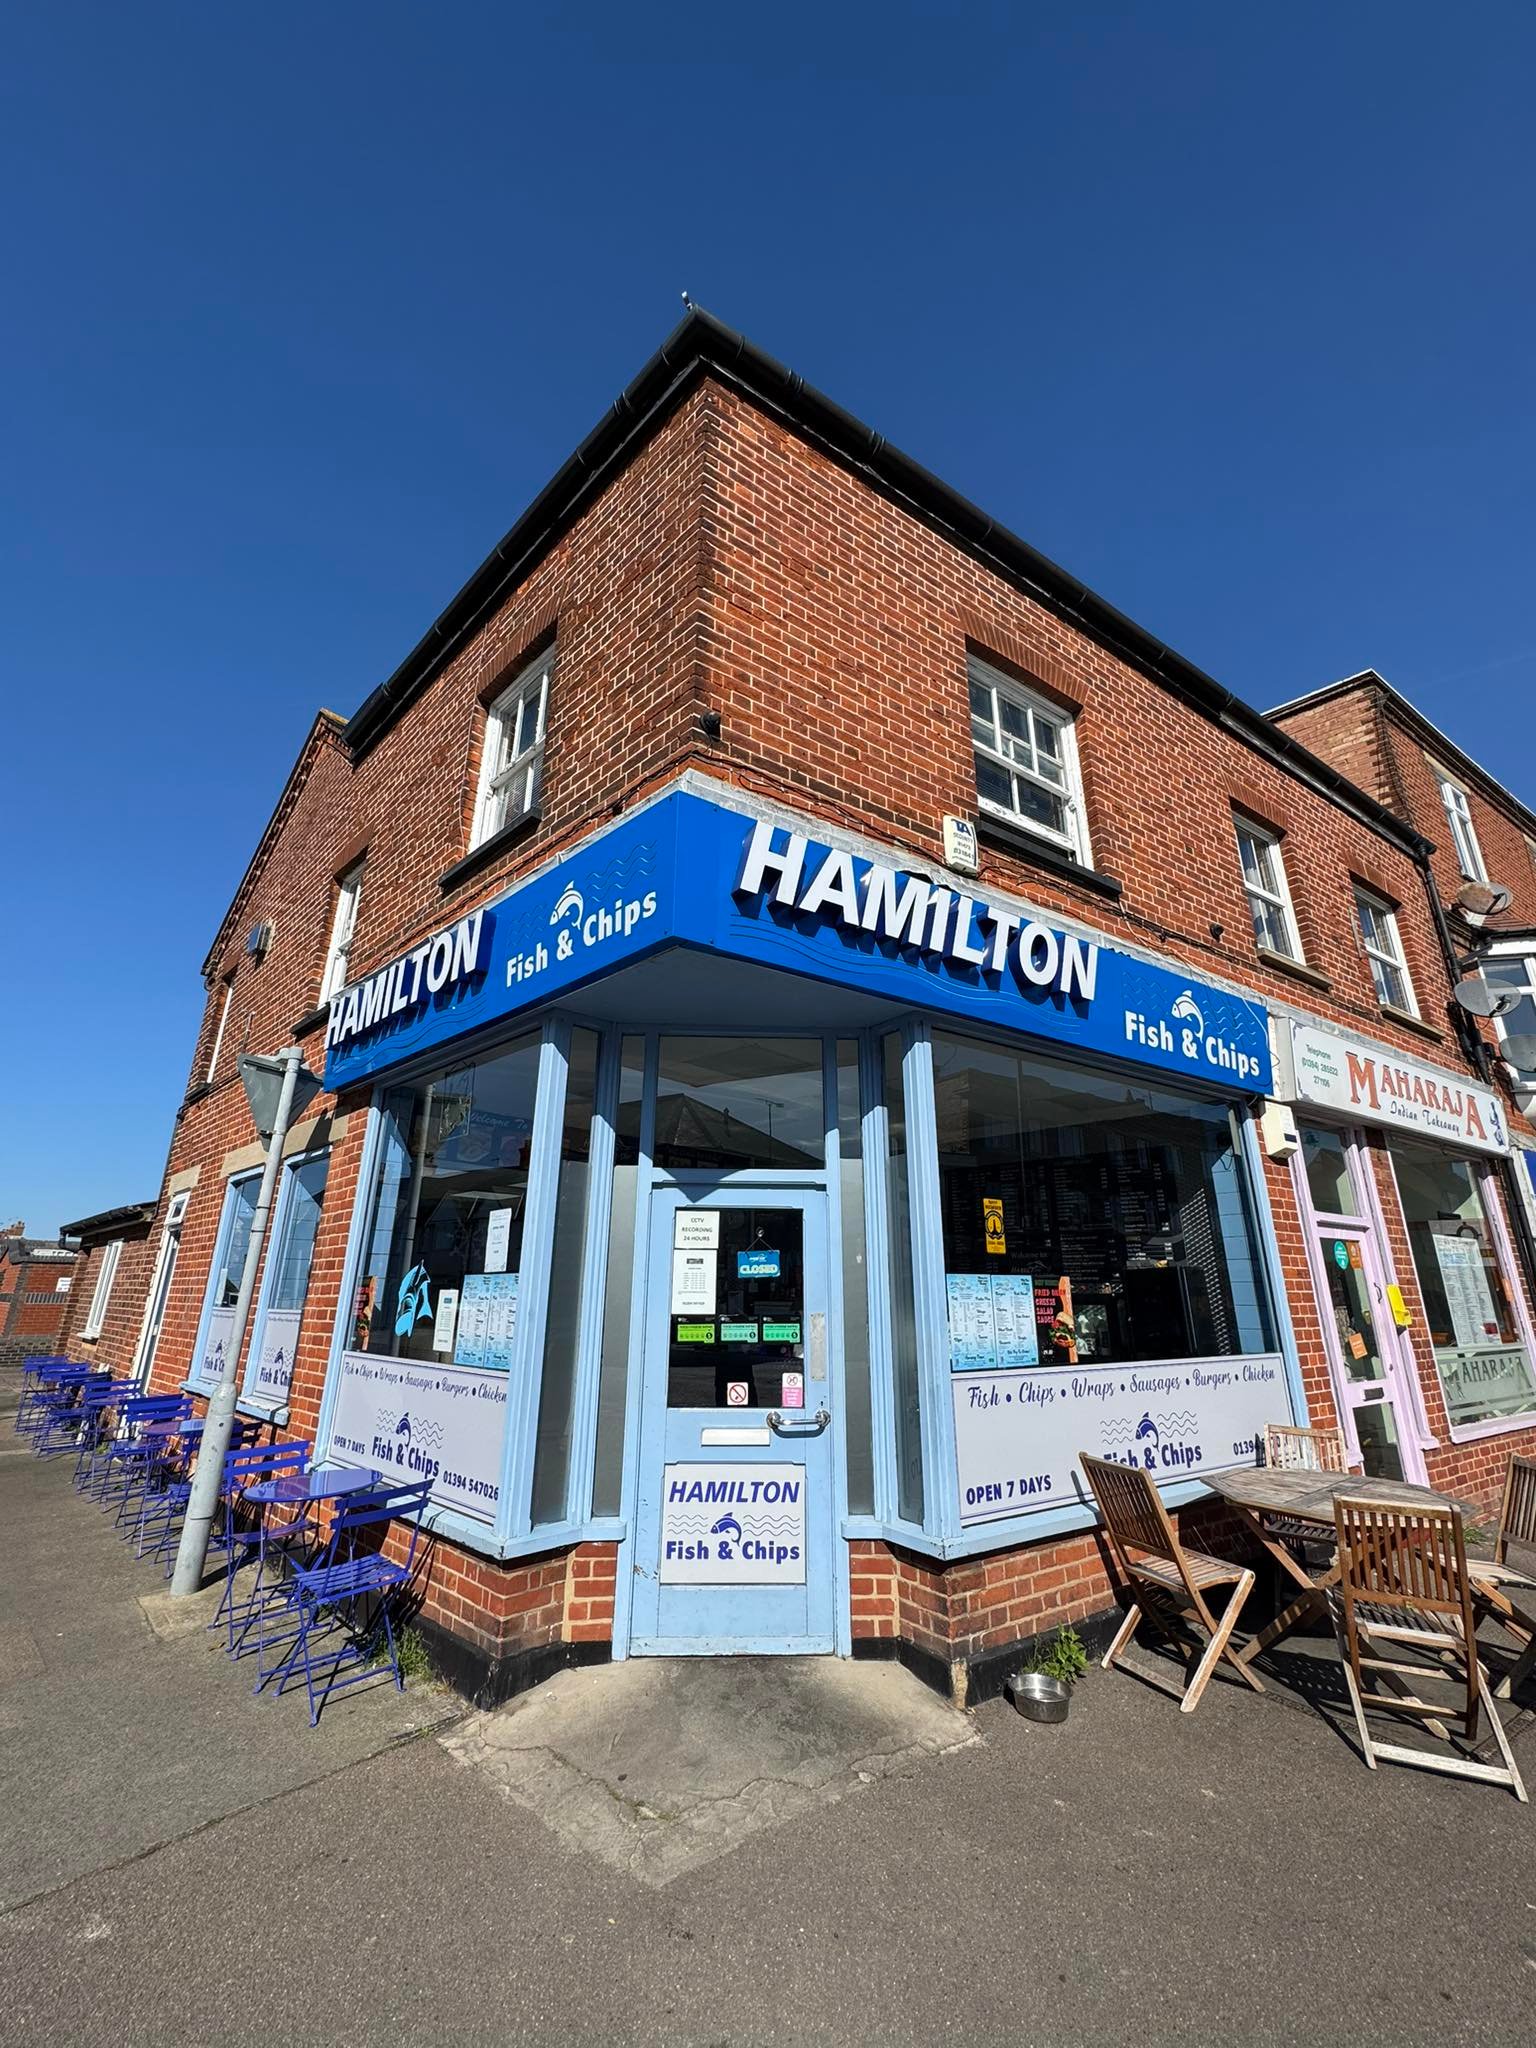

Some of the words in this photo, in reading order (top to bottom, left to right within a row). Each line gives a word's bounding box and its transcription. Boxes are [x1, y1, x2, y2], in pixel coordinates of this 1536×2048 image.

[739, 820, 1100, 1001] HAMILTON
[506, 942, 548, 988] Fish
[557, 929, 574, 962] &
[582, 890, 657, 948] Chips
[325, 909, 486, 1050] HAMILTON
[1123, 1010, 1174, 1053] Fish
[1182, 1026, 1198, 1060] &
[1204, 1035, 1261, 1080] Chips
[1345, 1051, 1488, 1140] MAHARAJA
[1390, 1100, 1418, 1122] Indian
[1422, 1109, 1461, 1137] Takeaway
[260, 1366, 272, 1384] Fish
[273, 1369, 279, 1385] &
[360, 1364, 373, 1381] Chips
[379, 1367, 399, 1384] Wraps
[404, 1371, 434, 1392] Sausages
[441, 1376, 470, 1398] Burgers
[478, 1383, 508, 1403] Chicken
[968, 1384, 1001, 1409] Fish
[1019, 1381, 1056, 1408] Chips
[1071, 1377, 1116, 1401] Wraps
[1129, 1373, 1182, 1395] Sausages
[1192, 1368, 1232, 1391] Burgers
[1242, 1363, 1276, 1383] Chicken
[333, 1434, 346, 1449] OPEN
[351, 1440, 366, 1455] DAYS
[371, 1435, 394, 1462] Fish
[395, 1442, 404, 1466] &
[407, 1446, 440, 1479] Chips
[1143, 1446, 1158, 1470] &
[1161, 1441, 1202, 1469] Chips
[442, 1470, 467, 1490] 01394
[468, 1478, 500, 1501] 547026
[668, 1480, 801, 1504] HAMILTON
[966, 1483, 1002, 1506] OPEN
[1006, 1481, 1015, 1498] 7
[1019, 1474, 1052, 1495] DAYS
[665, 1540, 710, 1561] Fish
[717, 1540, 734, 1561] &
[741, 1540, 801, 1565] Chips
